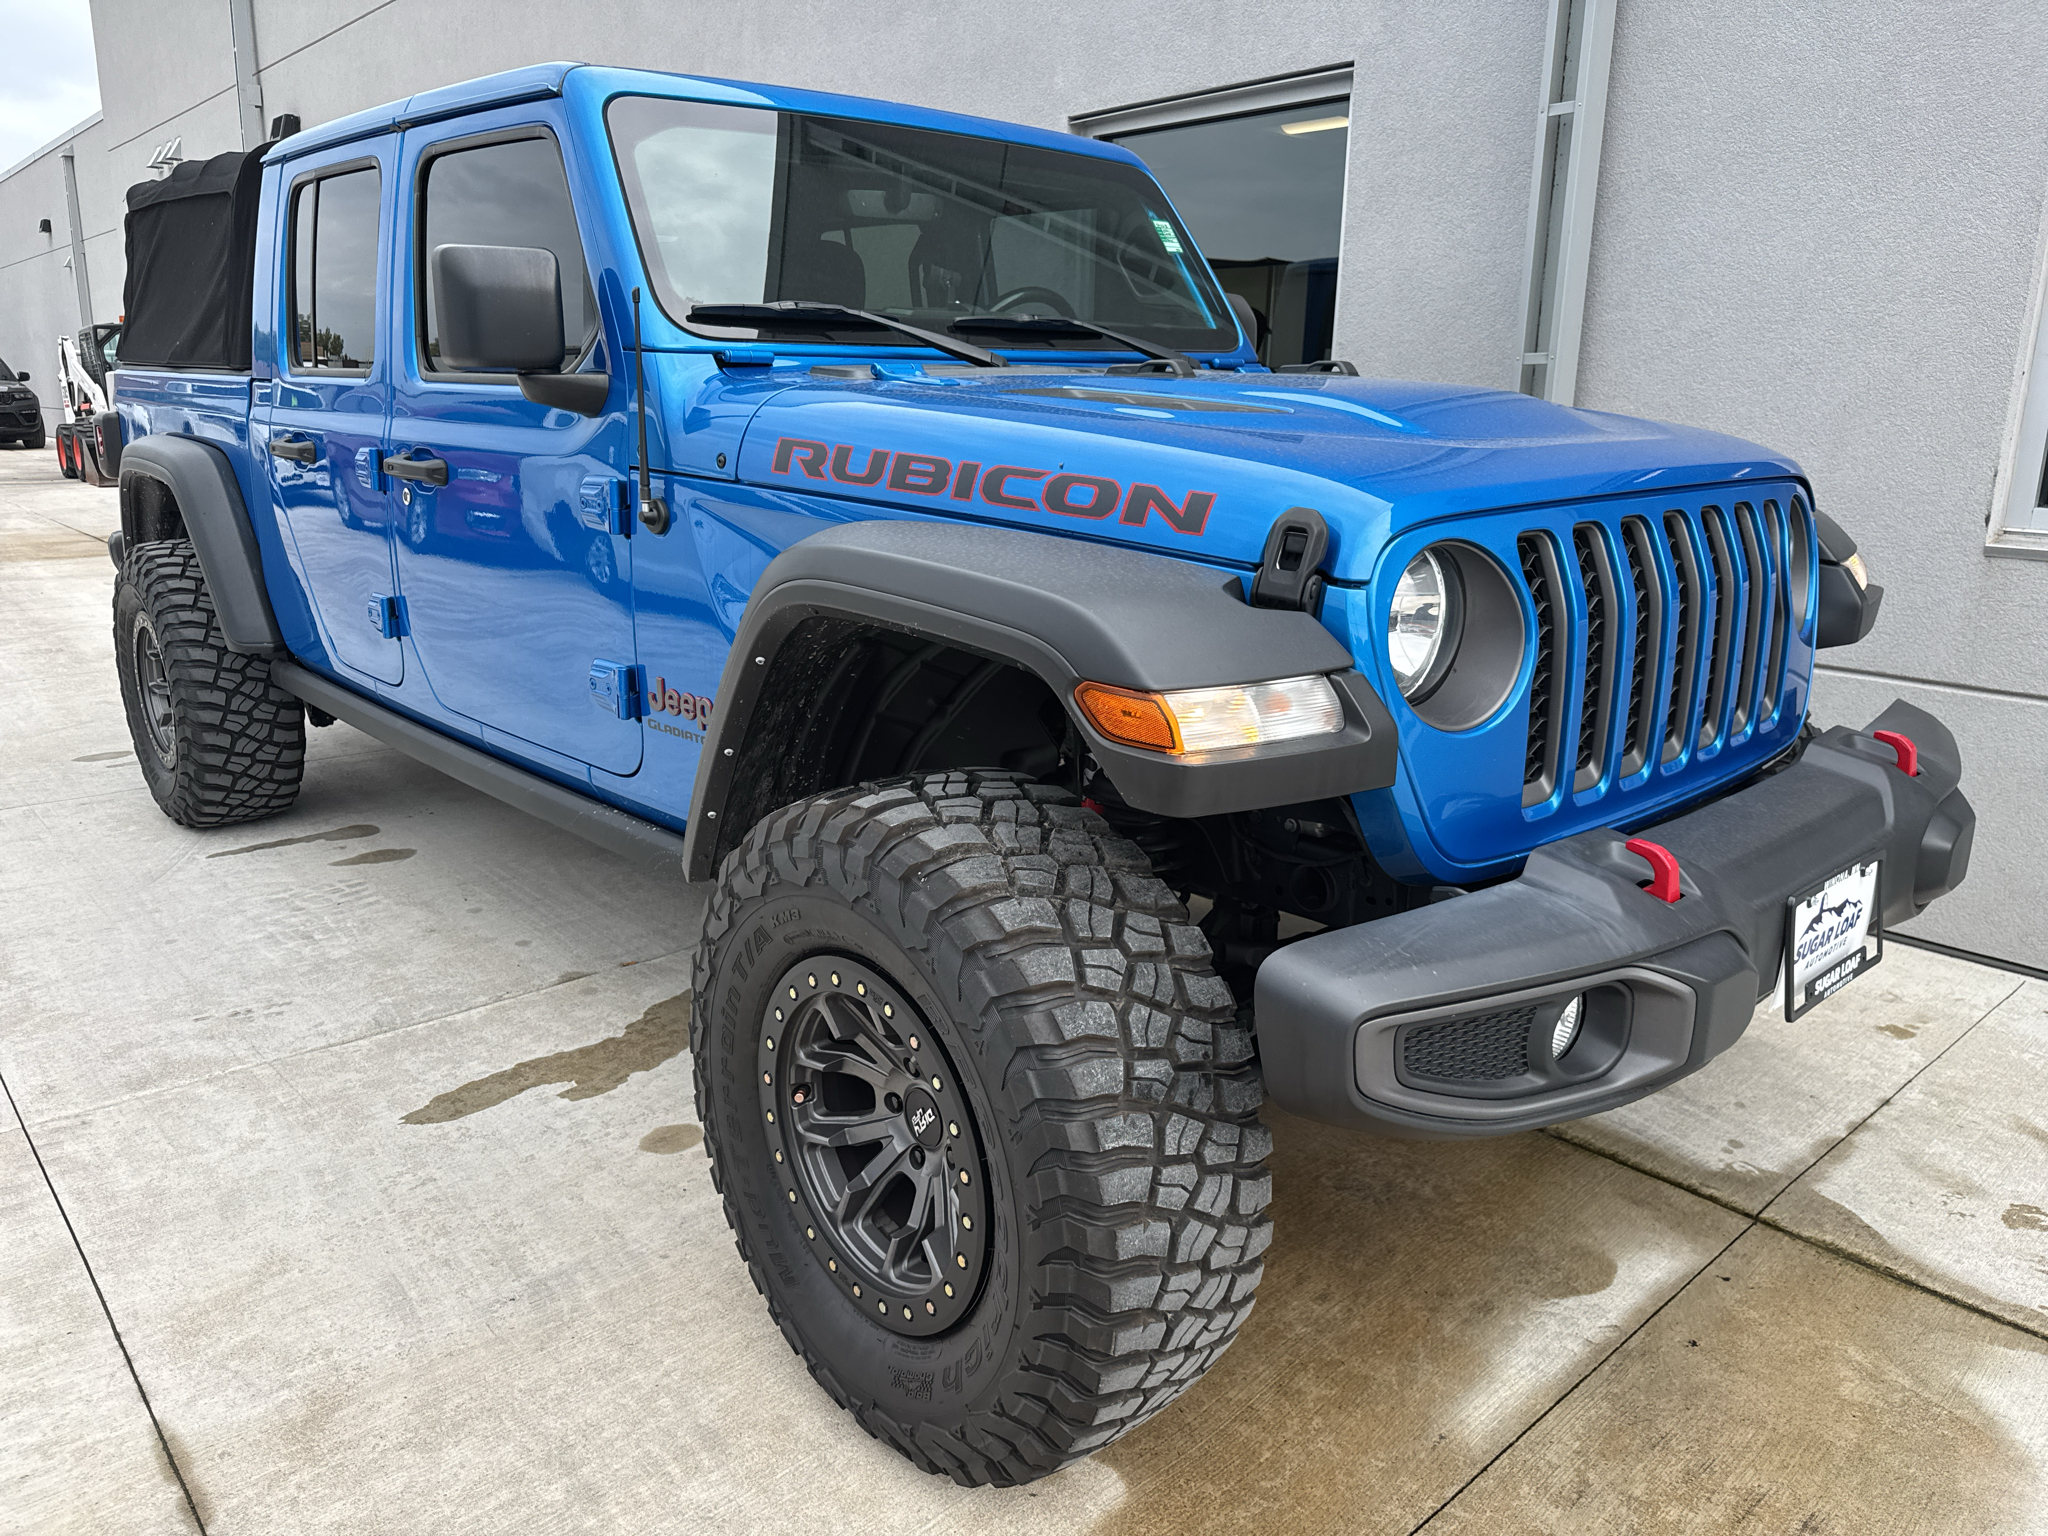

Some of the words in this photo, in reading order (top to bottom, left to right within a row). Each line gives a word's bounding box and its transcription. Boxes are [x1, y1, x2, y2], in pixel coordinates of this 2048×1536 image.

[771, 436, 1218, 537] RUBICON
[647, 676, 714, 731] Jeep
[770, 908, 802, 929] KM3
[1794, 927, 1833, 965] SUGAR
[1834, 907, 1863, 941] LOAF
[731, 924, 775, 985] T/A
[1804, 936, 1848, 971] AUTOMOTIVE
[1814, 967, 1840, 996] SUGAR
[1841, 952, 1862, 979] LOAF
[1823, 973, 1854, 999] AUTOMOTIVE
[716, 985, 800, 1292] Mud-Terrain
[913, 1107, 936, 1138] DIRTY
[887, 1365, 936, 1382] Champion
[905, 1390, 934, 1402] Baja
